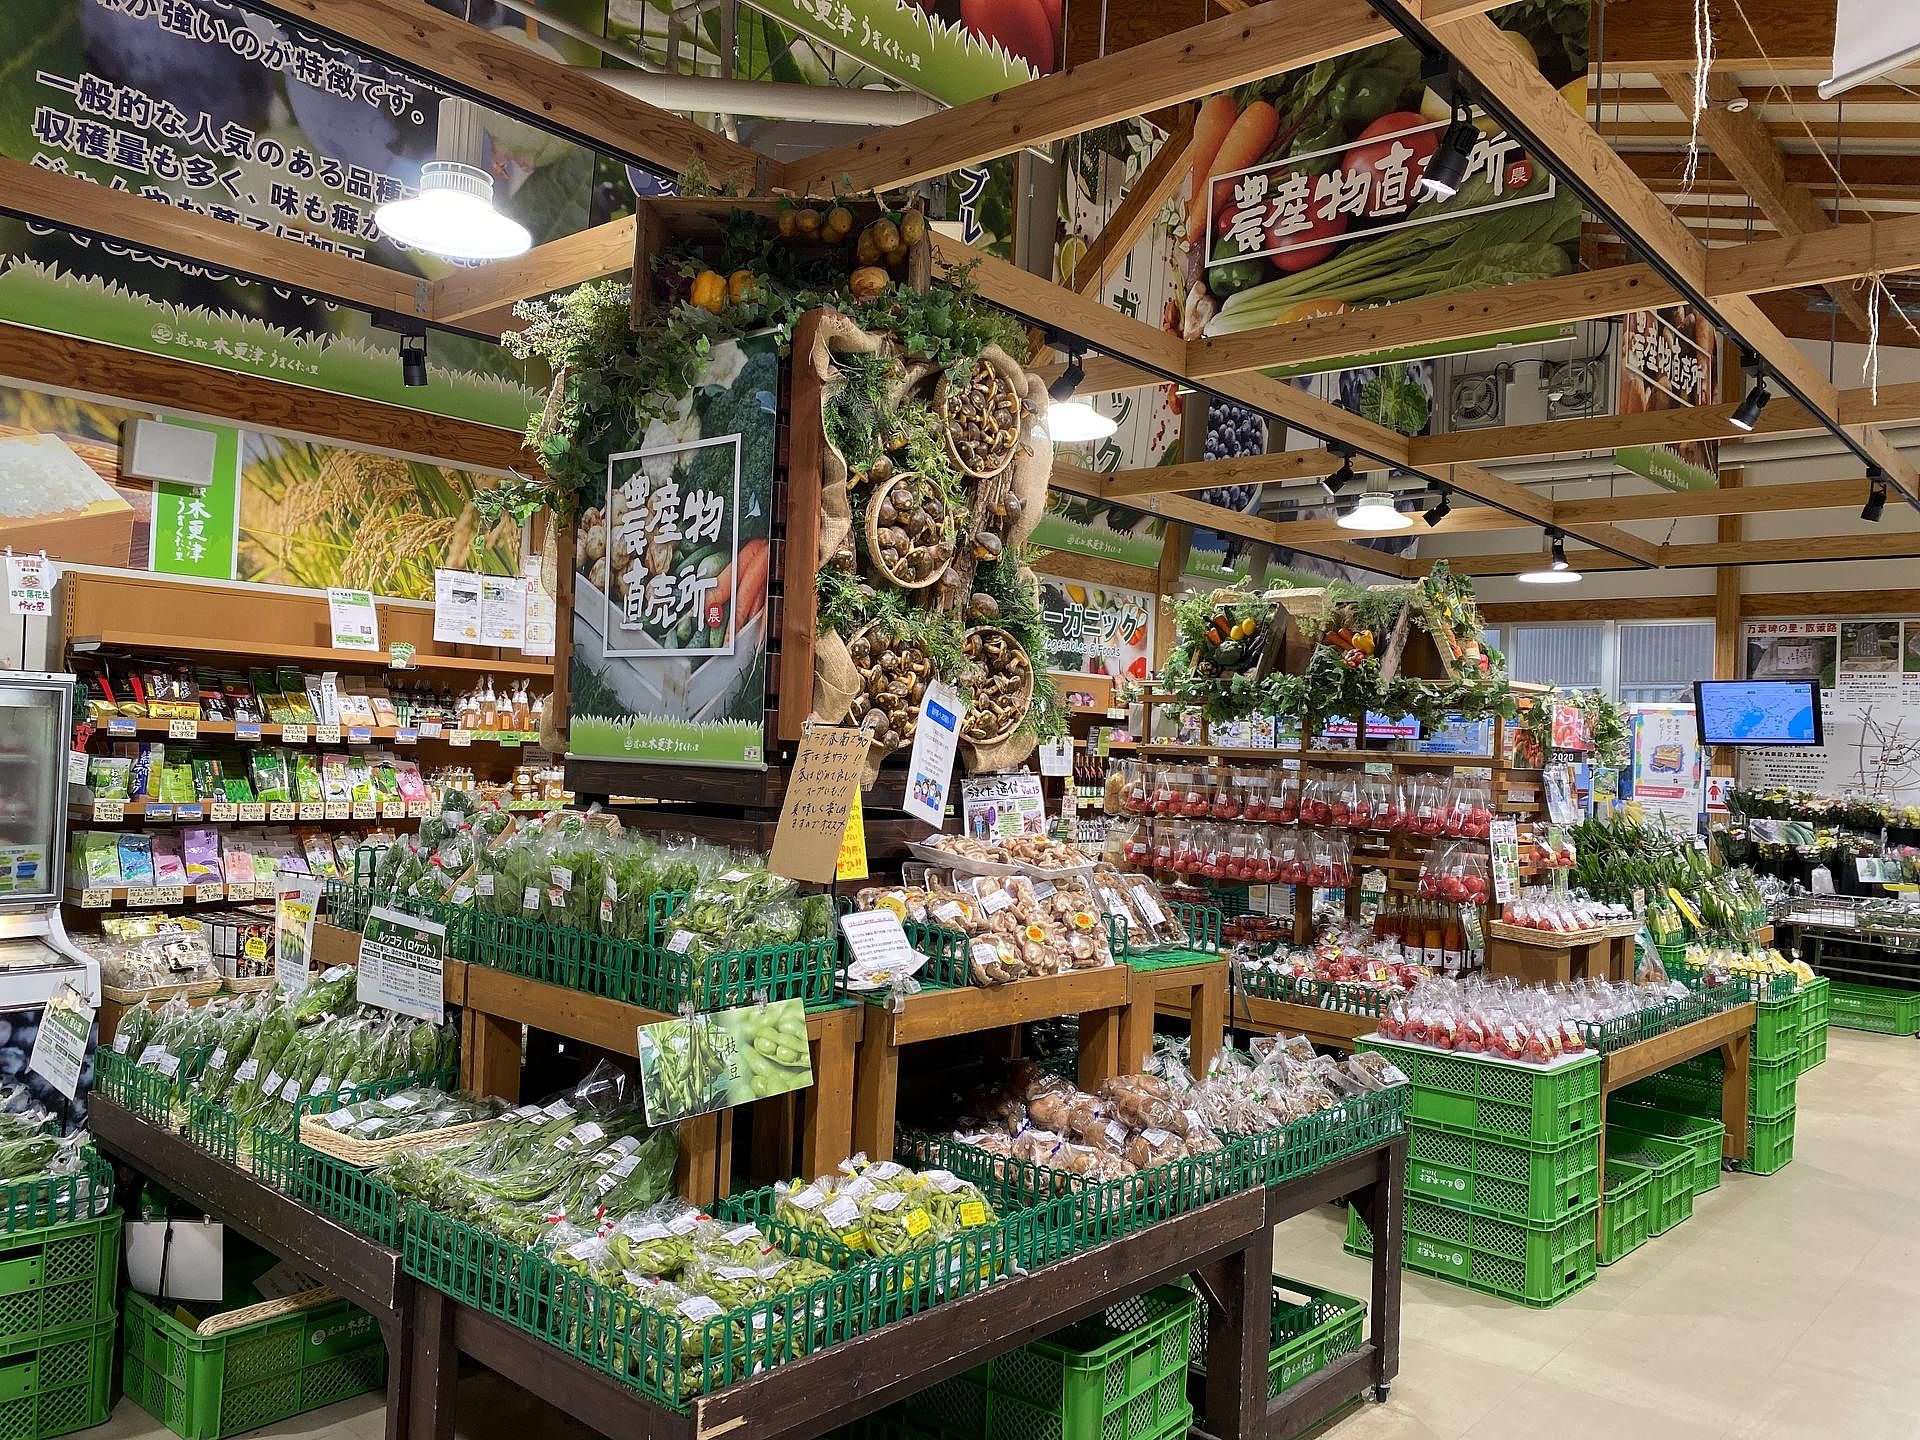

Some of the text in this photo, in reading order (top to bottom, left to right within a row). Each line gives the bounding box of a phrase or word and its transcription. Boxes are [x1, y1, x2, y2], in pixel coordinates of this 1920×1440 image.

[98, 0, 426, 125] が強いのが特徴です。
[36, 70, 418, 203] 一般的な人気のある品種
[211, 337, 267, 365] 木更津
[184, 498, 212, 564] 木更津
[615, 473, 724, 555] 農産物
[619, 557, 721, 632] 直売所 農
[1552, 753, 1574, 762] 2020
